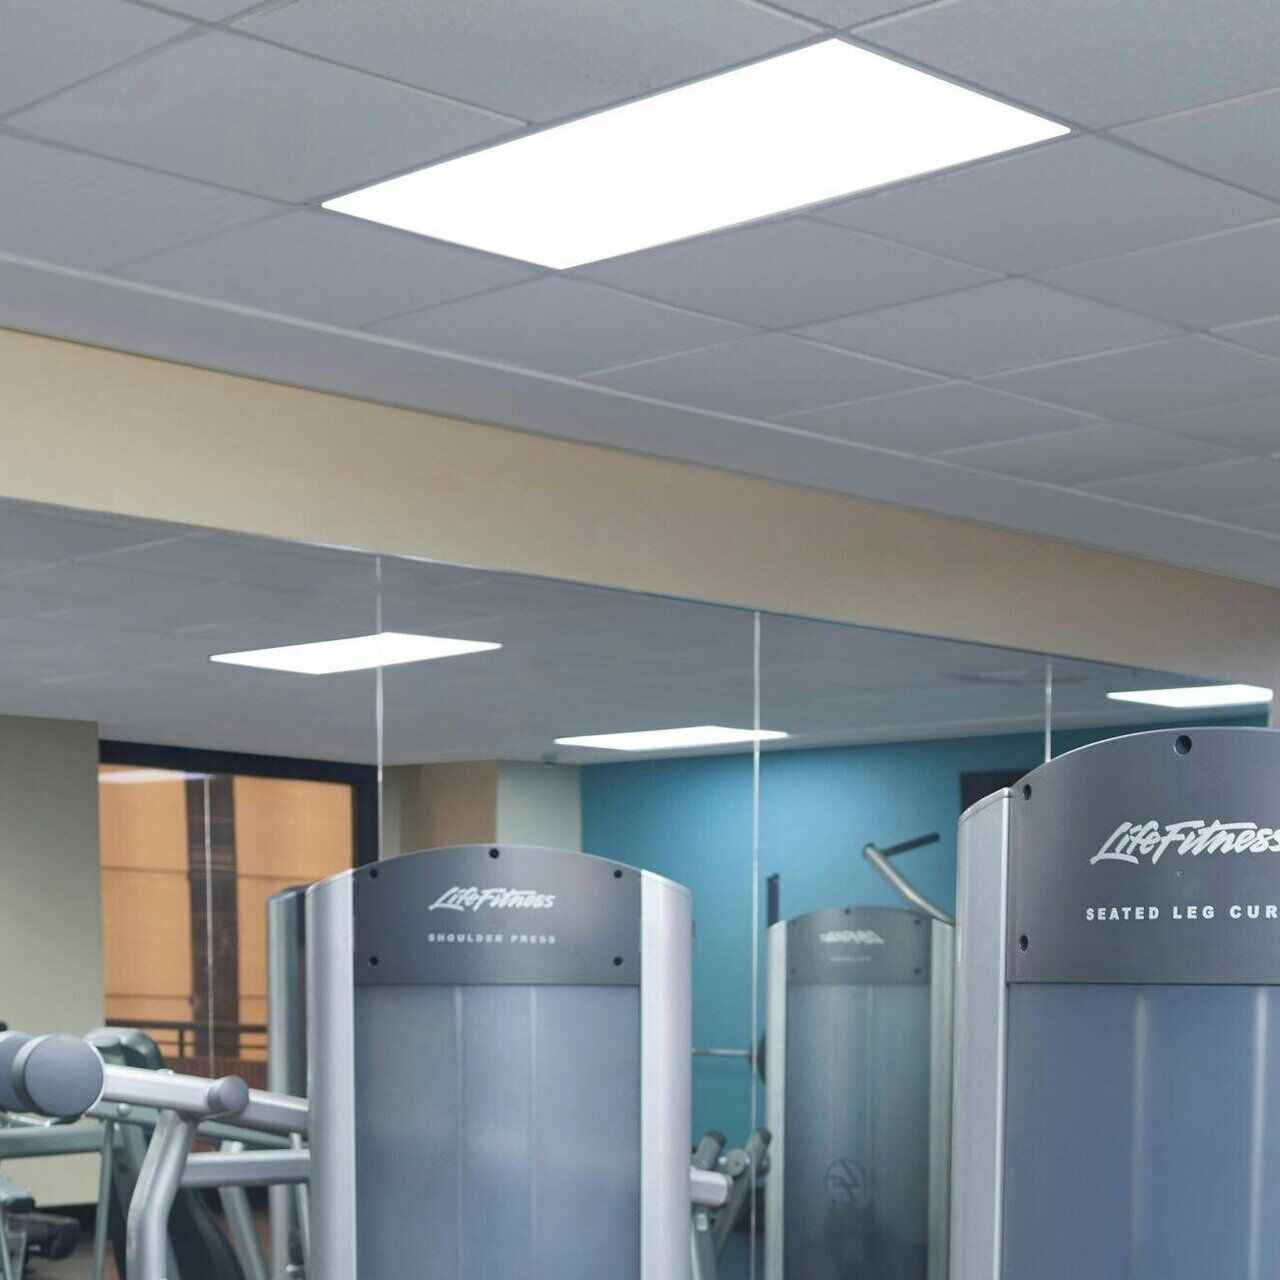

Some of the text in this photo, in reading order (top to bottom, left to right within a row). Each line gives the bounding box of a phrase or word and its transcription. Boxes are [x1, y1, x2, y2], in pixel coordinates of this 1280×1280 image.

[1085, 906, 1160, 921] SEATED
[1172, 905, 1216, 920] LEG
[428, 933, 556, 944] SHOULDER PRESS
